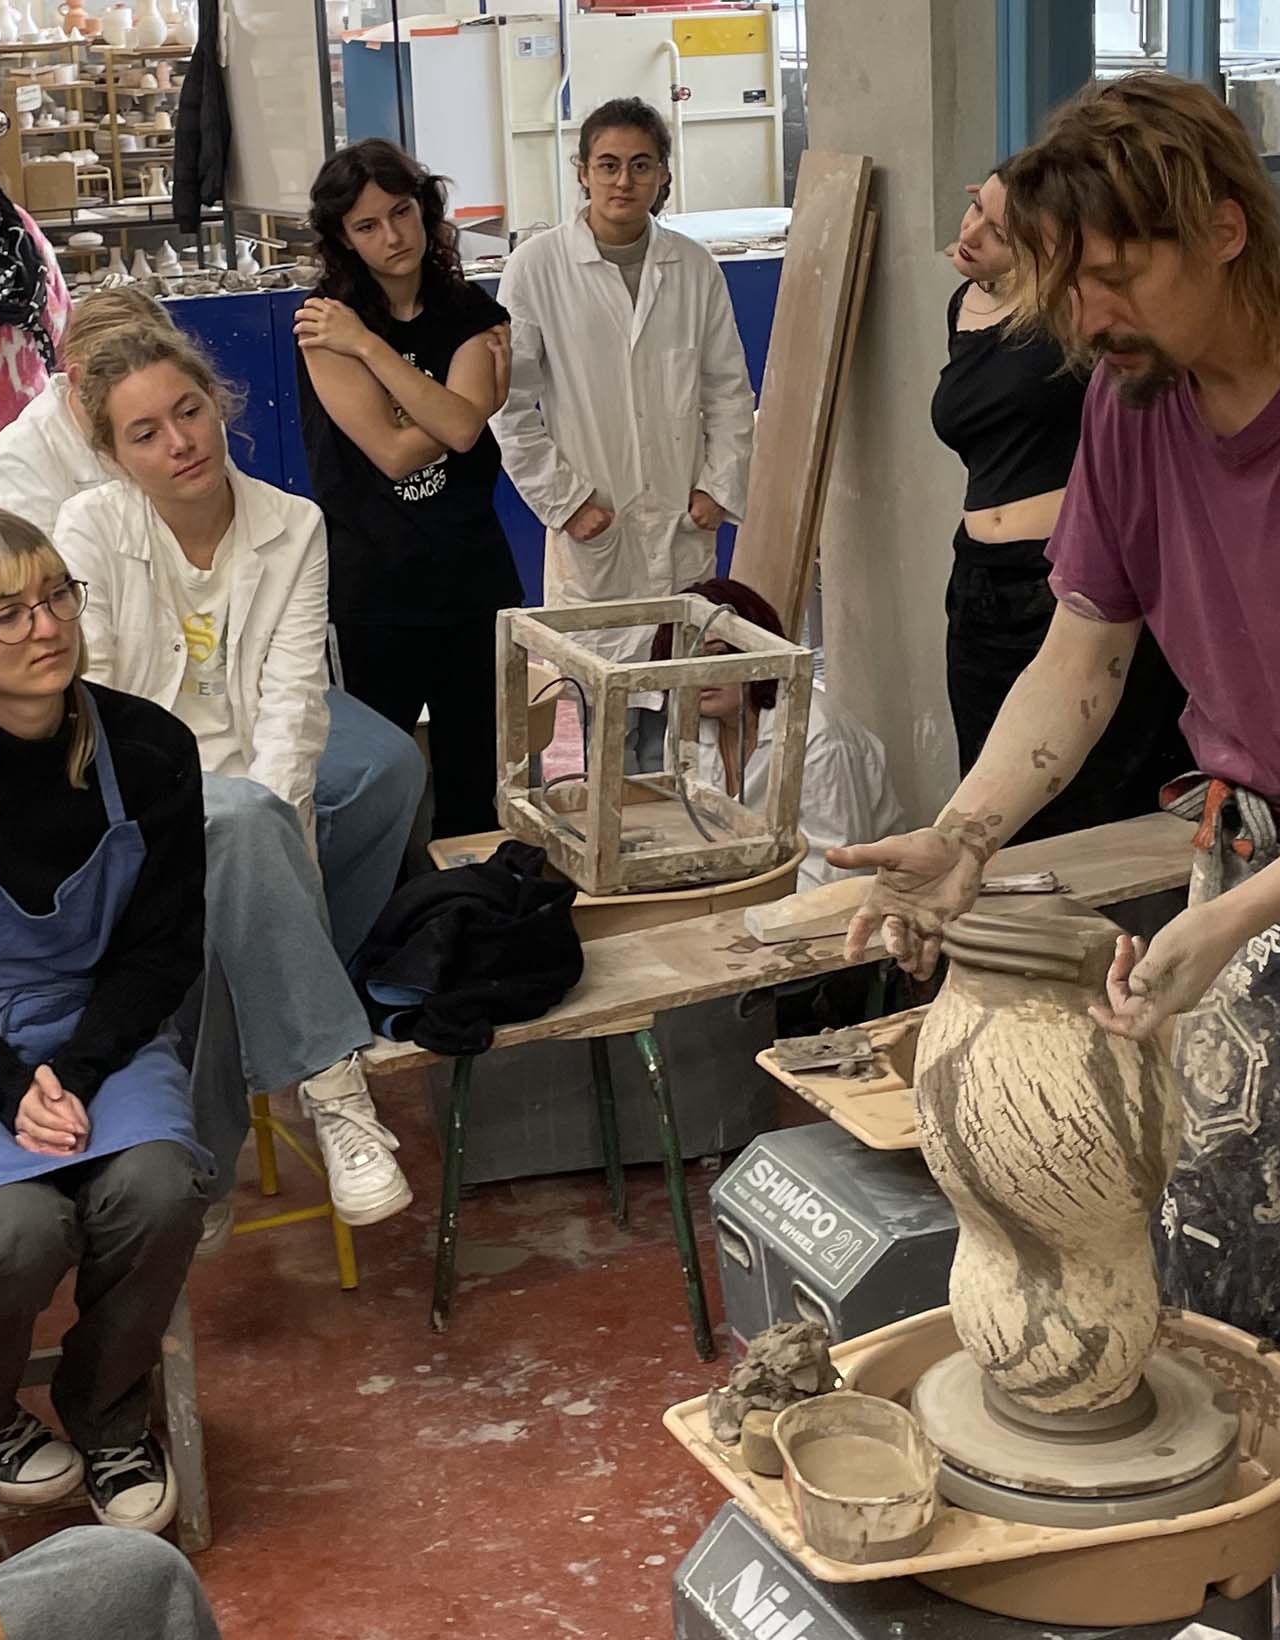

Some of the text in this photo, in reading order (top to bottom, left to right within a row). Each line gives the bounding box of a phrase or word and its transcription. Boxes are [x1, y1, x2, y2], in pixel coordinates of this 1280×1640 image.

[744, 1159, 838, 1239] SHIMPO
[820, 1229, 863, 1270] 21
[778, 1219, 818, 1256] WHEEL
[717, 1559, 815, 1640] Nid
